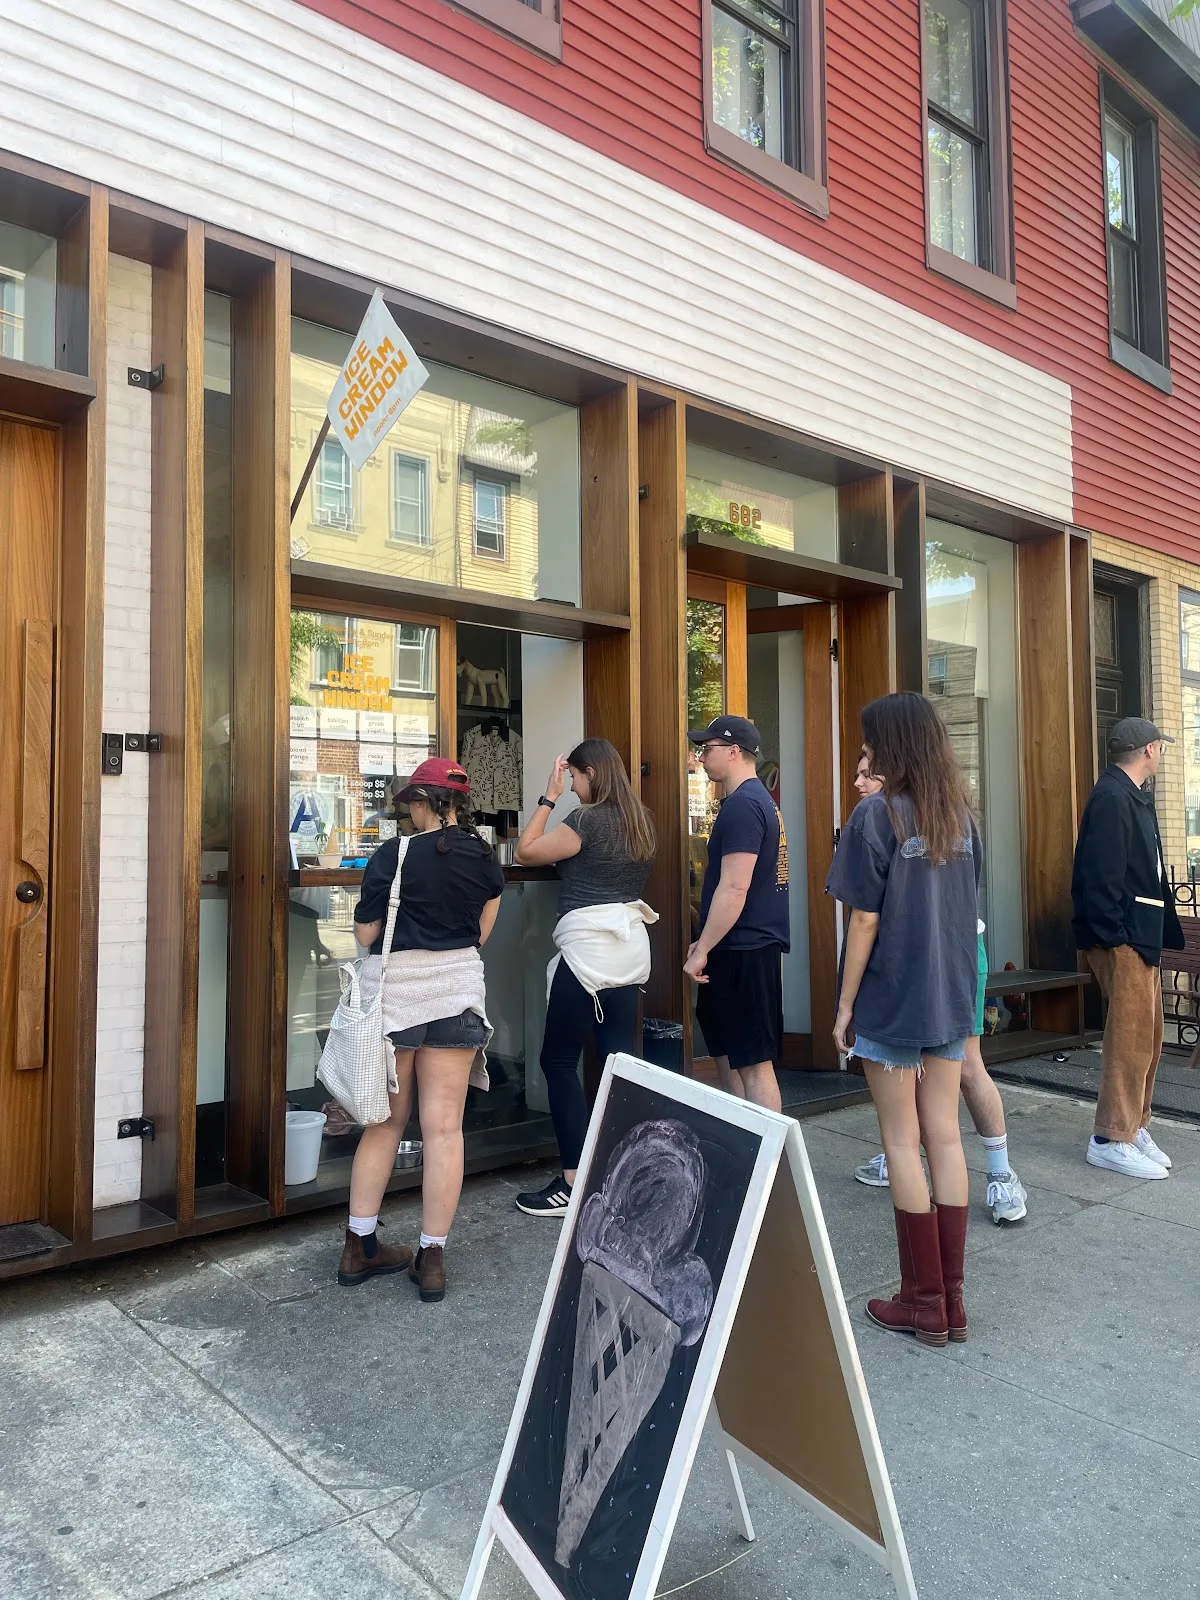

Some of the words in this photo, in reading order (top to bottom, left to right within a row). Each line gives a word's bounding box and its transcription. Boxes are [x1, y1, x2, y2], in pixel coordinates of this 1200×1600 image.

[343, 339, 371, 386] ICE
[338, 335, 395, 421] CREAM
[343, 349, 409, 442] WINDOW
[729, 502, 761, 529] 682
[344, 654, 374, 672] ICE
[327, 671, 390, 694] CREAM
[323, 689, 392, 712] WINDOW
[350, 791, 373, 800] scoop
[374, 790, 385, 799] $3
[351, 780, 373, 789] scoop
[374, 780, 385, 789] $5
[289, 790, 321, 833] A
